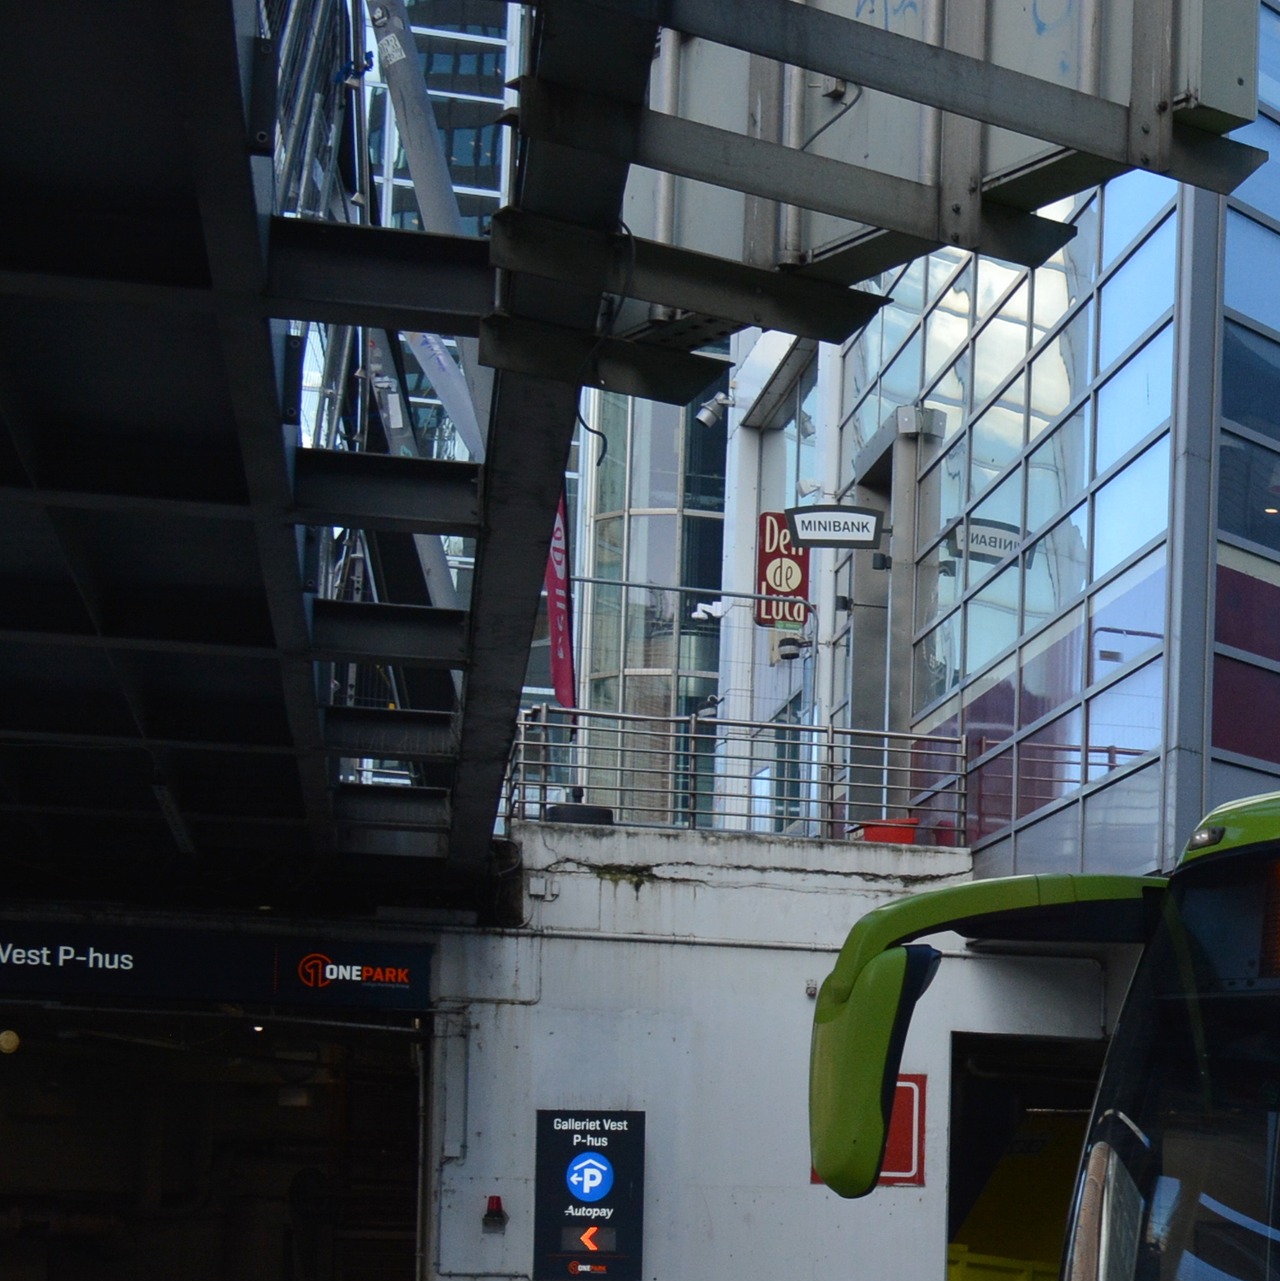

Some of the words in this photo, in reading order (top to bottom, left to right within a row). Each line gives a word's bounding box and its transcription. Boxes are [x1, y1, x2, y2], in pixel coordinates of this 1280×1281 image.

[765, 515, 803, 556] De
[801, 520, 870, 533] MINIBANK
[773, 558, 794, 590] de
[761, 581, 804, 622] Luca
[0, 943, 51, 966] Vest
[58, 945, 134, 970] P-hus
[325, 964, 410, 983] ONEPARK
[553, 1118, 601, 1131] Galleriet
[603, 1119, 629, 1131] Vest
[573, 1134, 608, 1147] P-hus
[564, 1205, 614, 1220] Autopay
